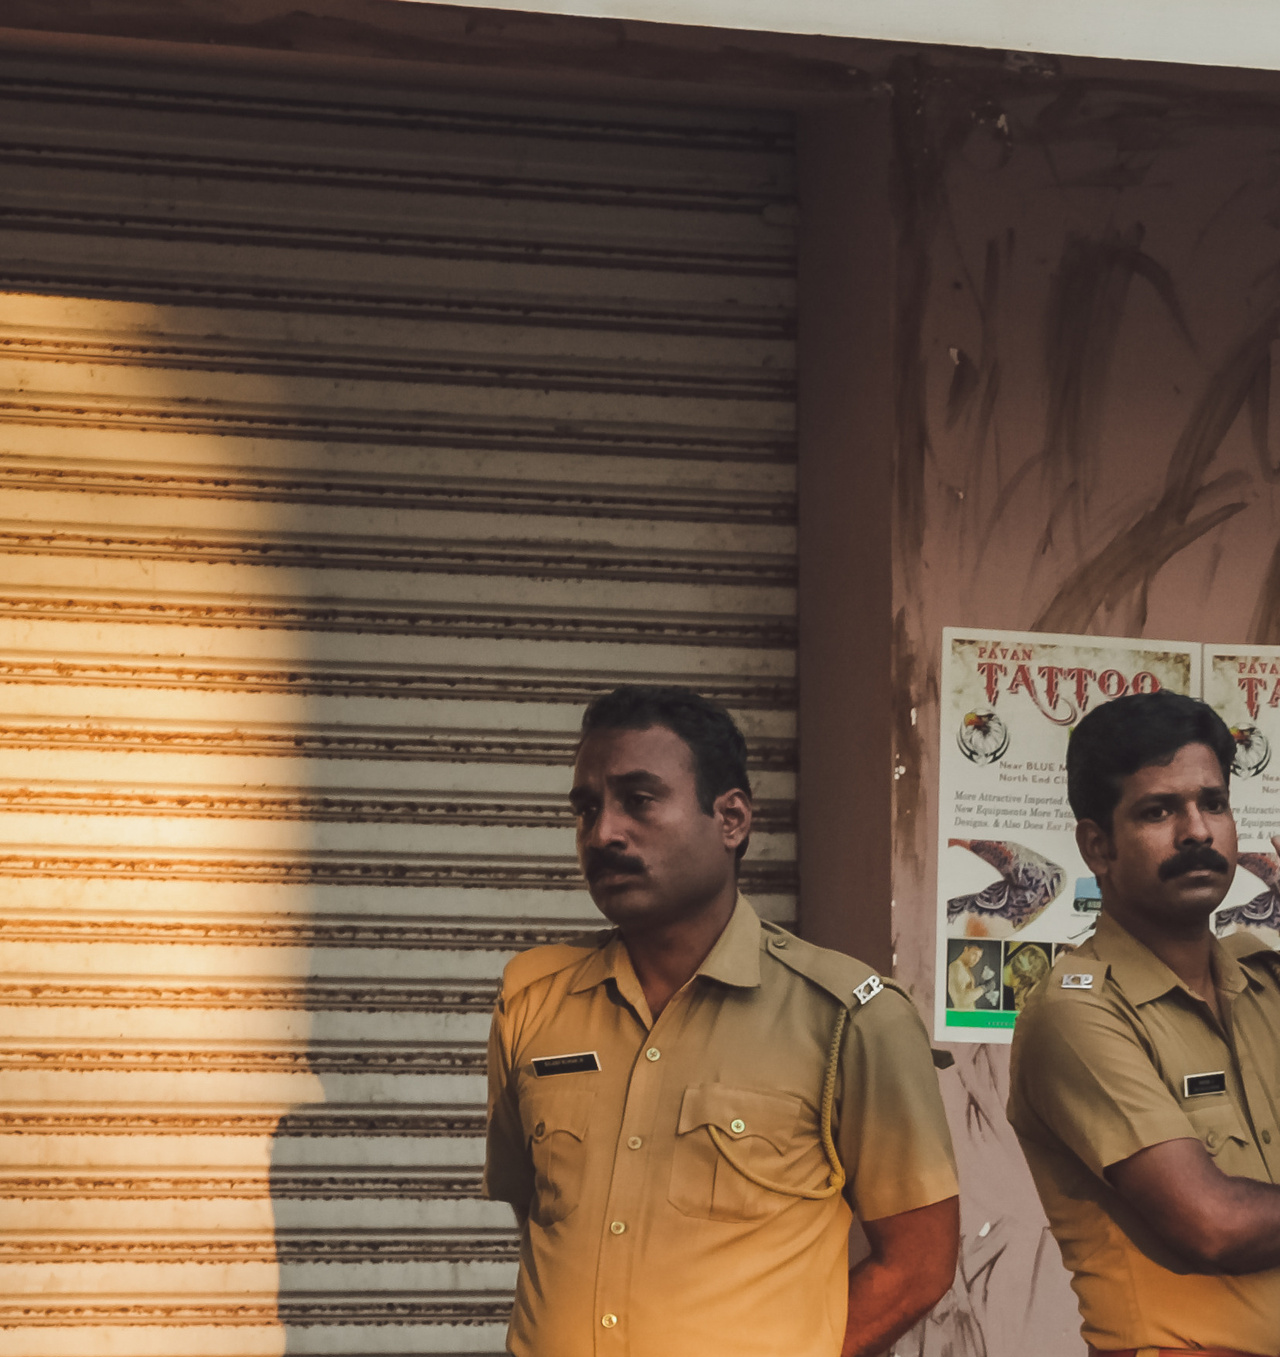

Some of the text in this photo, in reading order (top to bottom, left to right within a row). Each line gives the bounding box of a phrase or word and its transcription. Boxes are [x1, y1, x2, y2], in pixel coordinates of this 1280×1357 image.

[977, 646, 1033, 661] PAVAN
[977, 662, 1161, 725] TATTOO
[1000, 761, 1023, 770] Near
[1026, 761, 1055, 772] BLUE
[1000, 773, 1028, 783] North
[1031, 775, 1050, 784] End
[954, 791, 977, 800] More
[978, 792, 1022, 803] Attractive
[1024, 794, 1064, 805] Imported
[954, 804, 973, 813] New
[976, 804, 1027, 817] Equipments
[1029, 808, 1052, 818] More
[992, 819, 1000, 828] &
[1002, 819, 1021, 829] Also
[1023, 820, 1044, 830] Does
